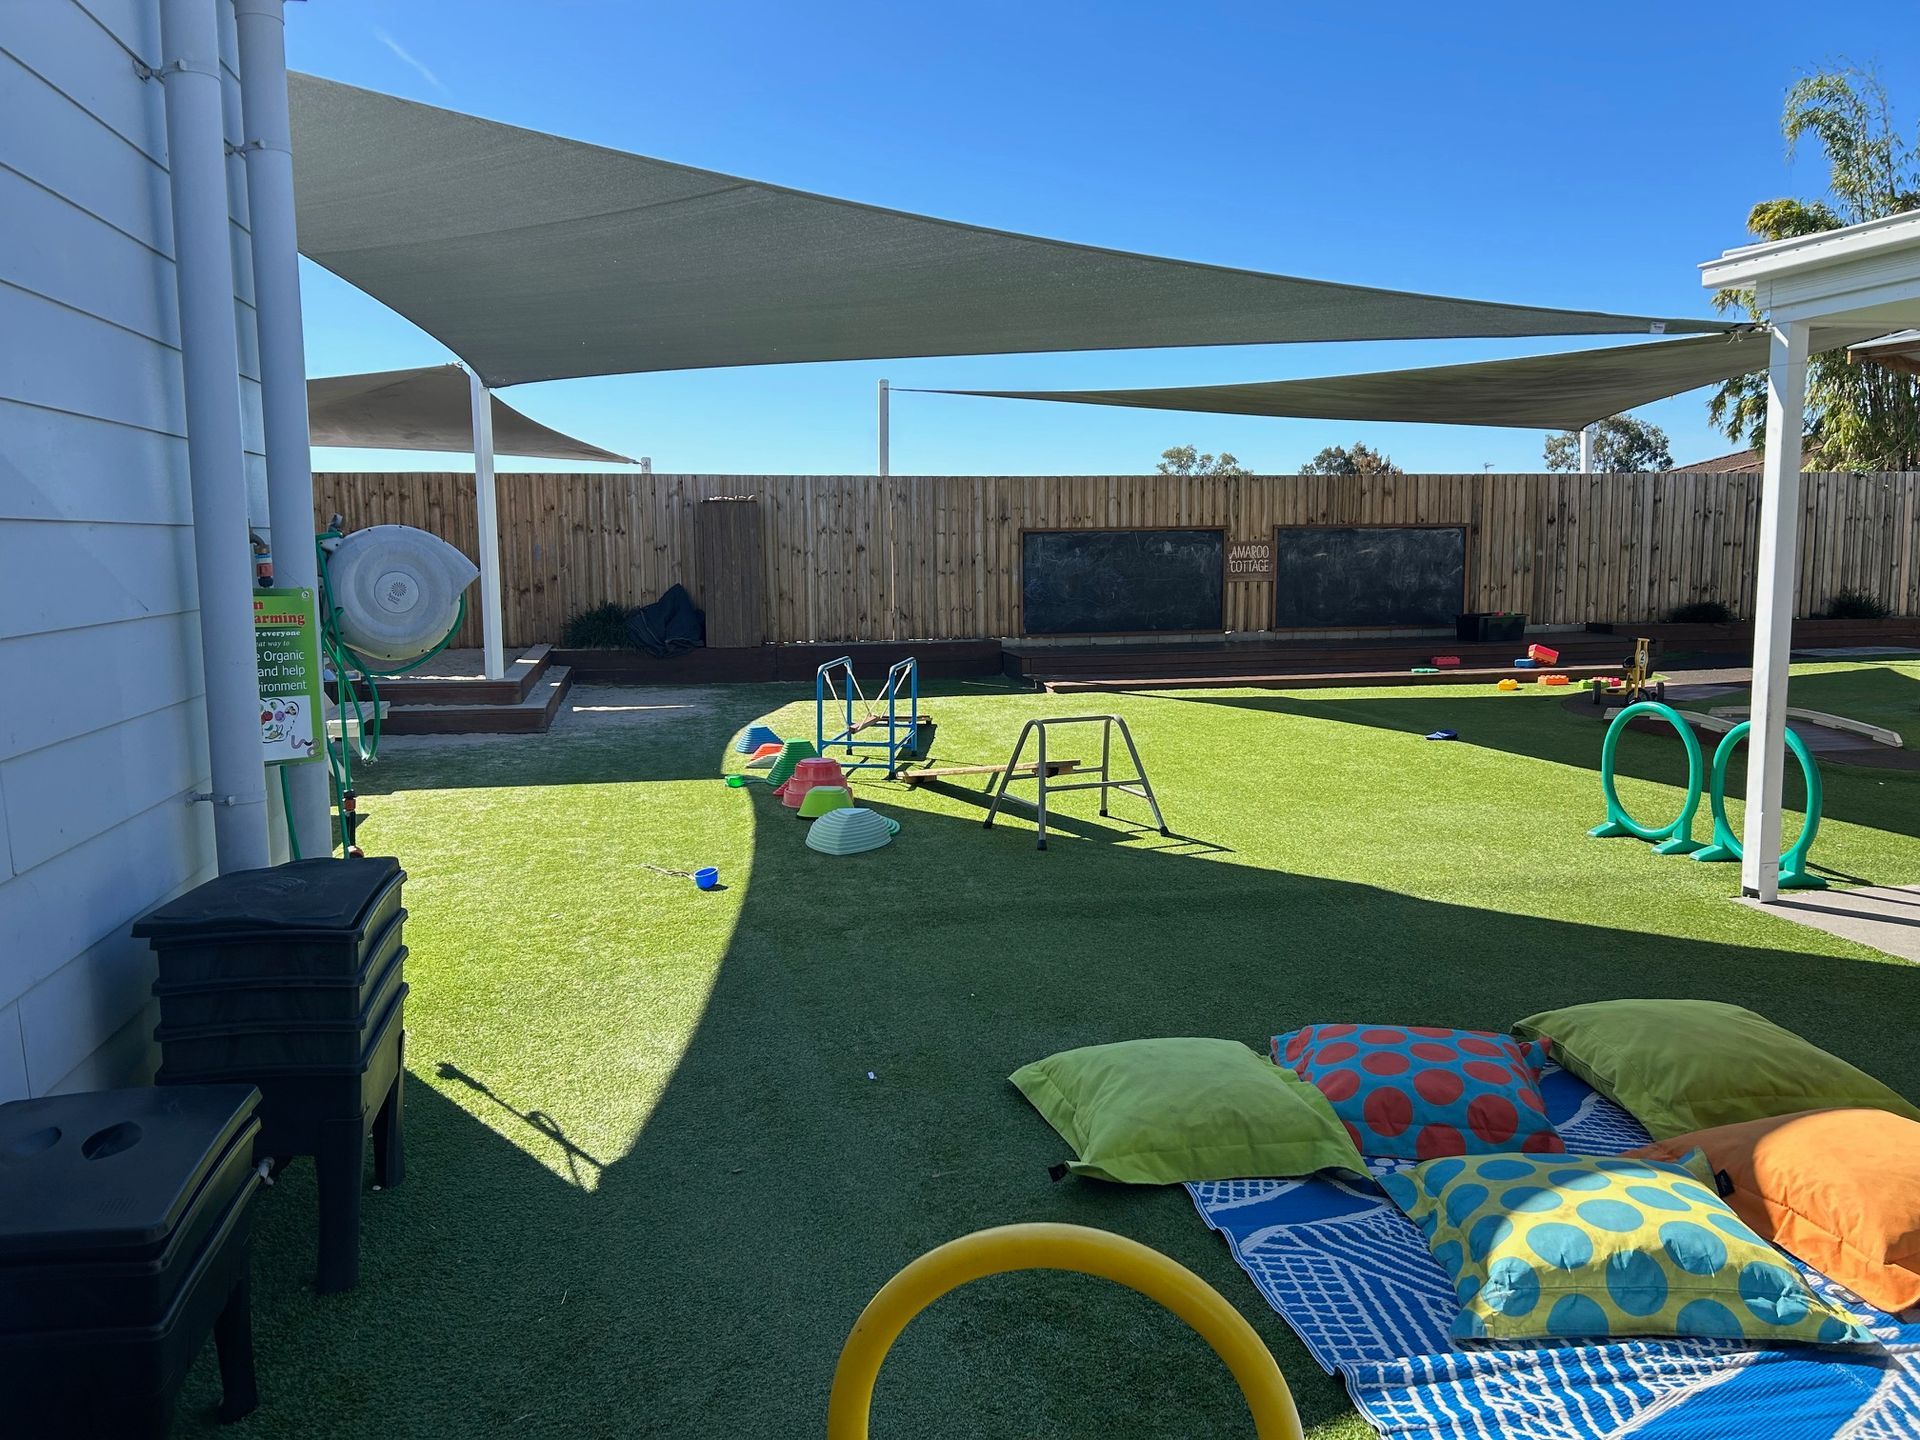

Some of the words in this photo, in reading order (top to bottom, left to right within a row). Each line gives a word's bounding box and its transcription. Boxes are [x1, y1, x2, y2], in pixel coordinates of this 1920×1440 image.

[1230, 545, 1269, 559] AMAROO
[1230, 560, 1269, 573] COTTAGE
[263, 650, 305, 663] Organic
[257, 665, 278, 677] and
[282, 664, 305, 677] help
